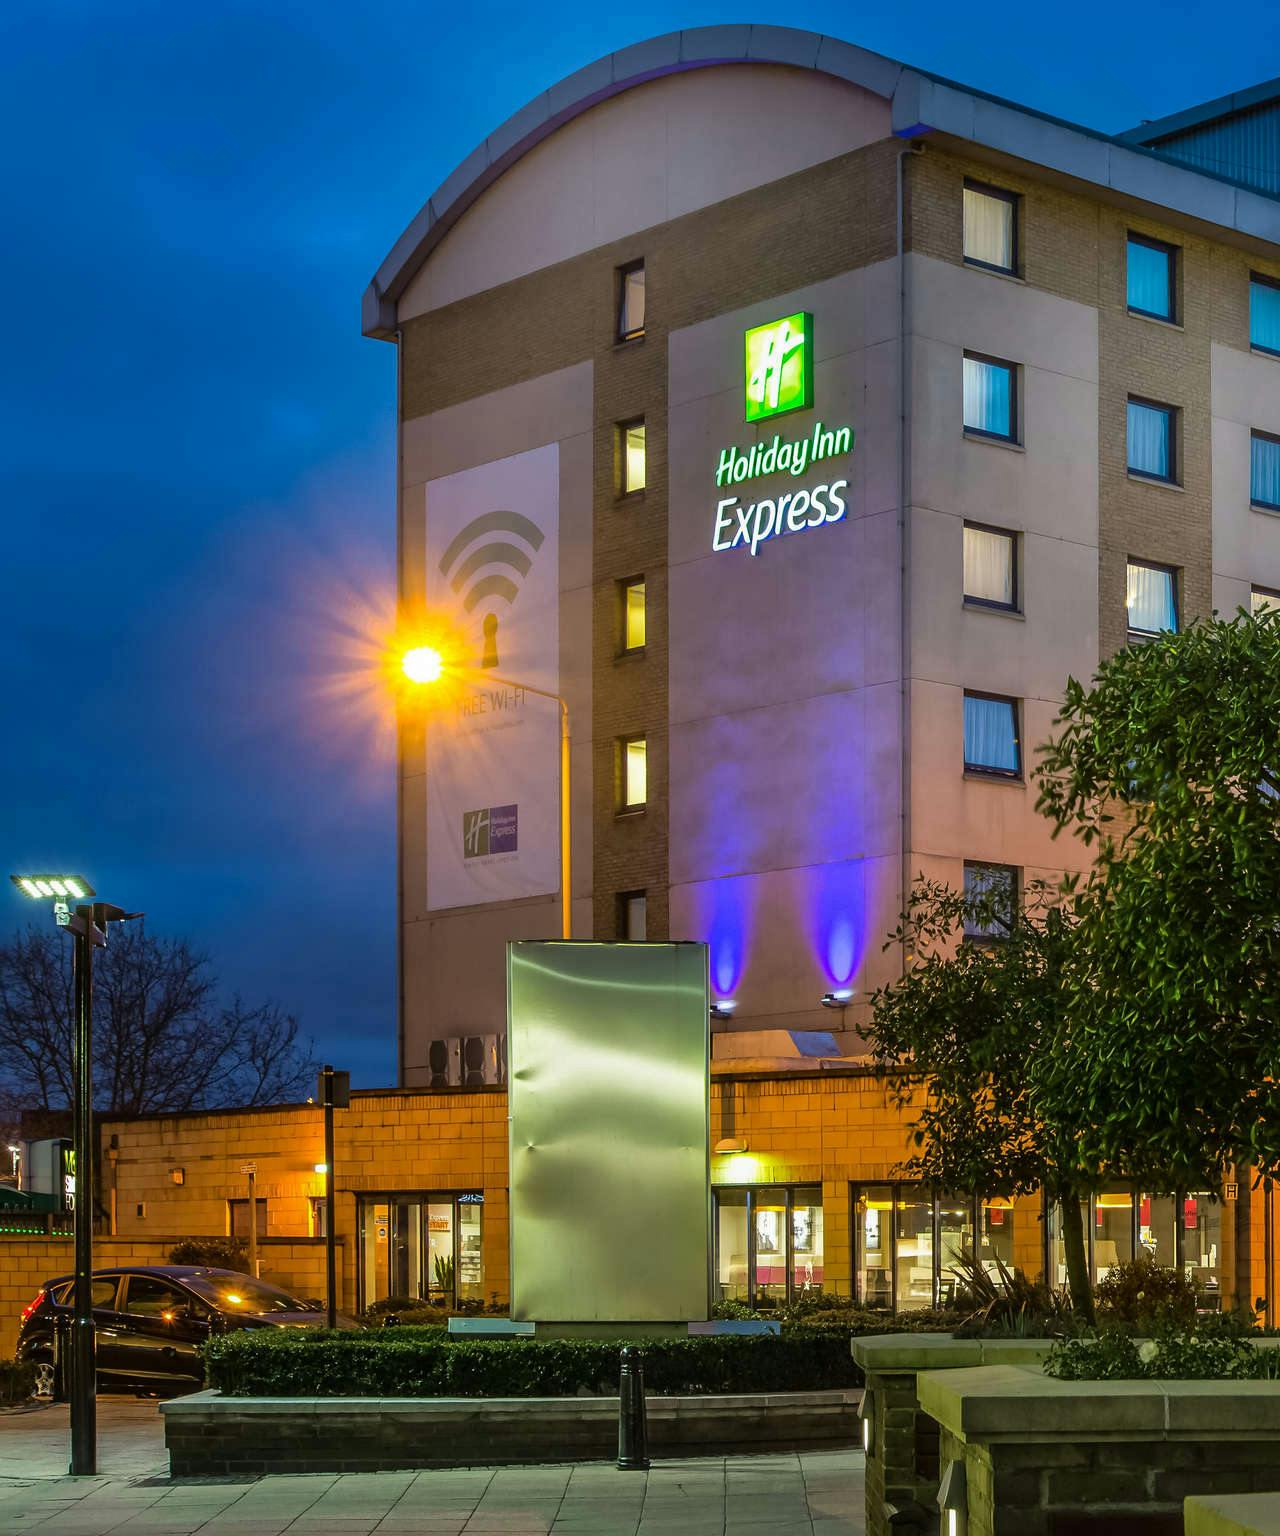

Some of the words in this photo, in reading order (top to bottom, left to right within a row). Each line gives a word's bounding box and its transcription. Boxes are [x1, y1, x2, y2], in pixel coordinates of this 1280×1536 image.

[715, 435, 809, 487] Holiday
[811, 422, 852, 462] Inn
[712, 480, 848, 556] Express
